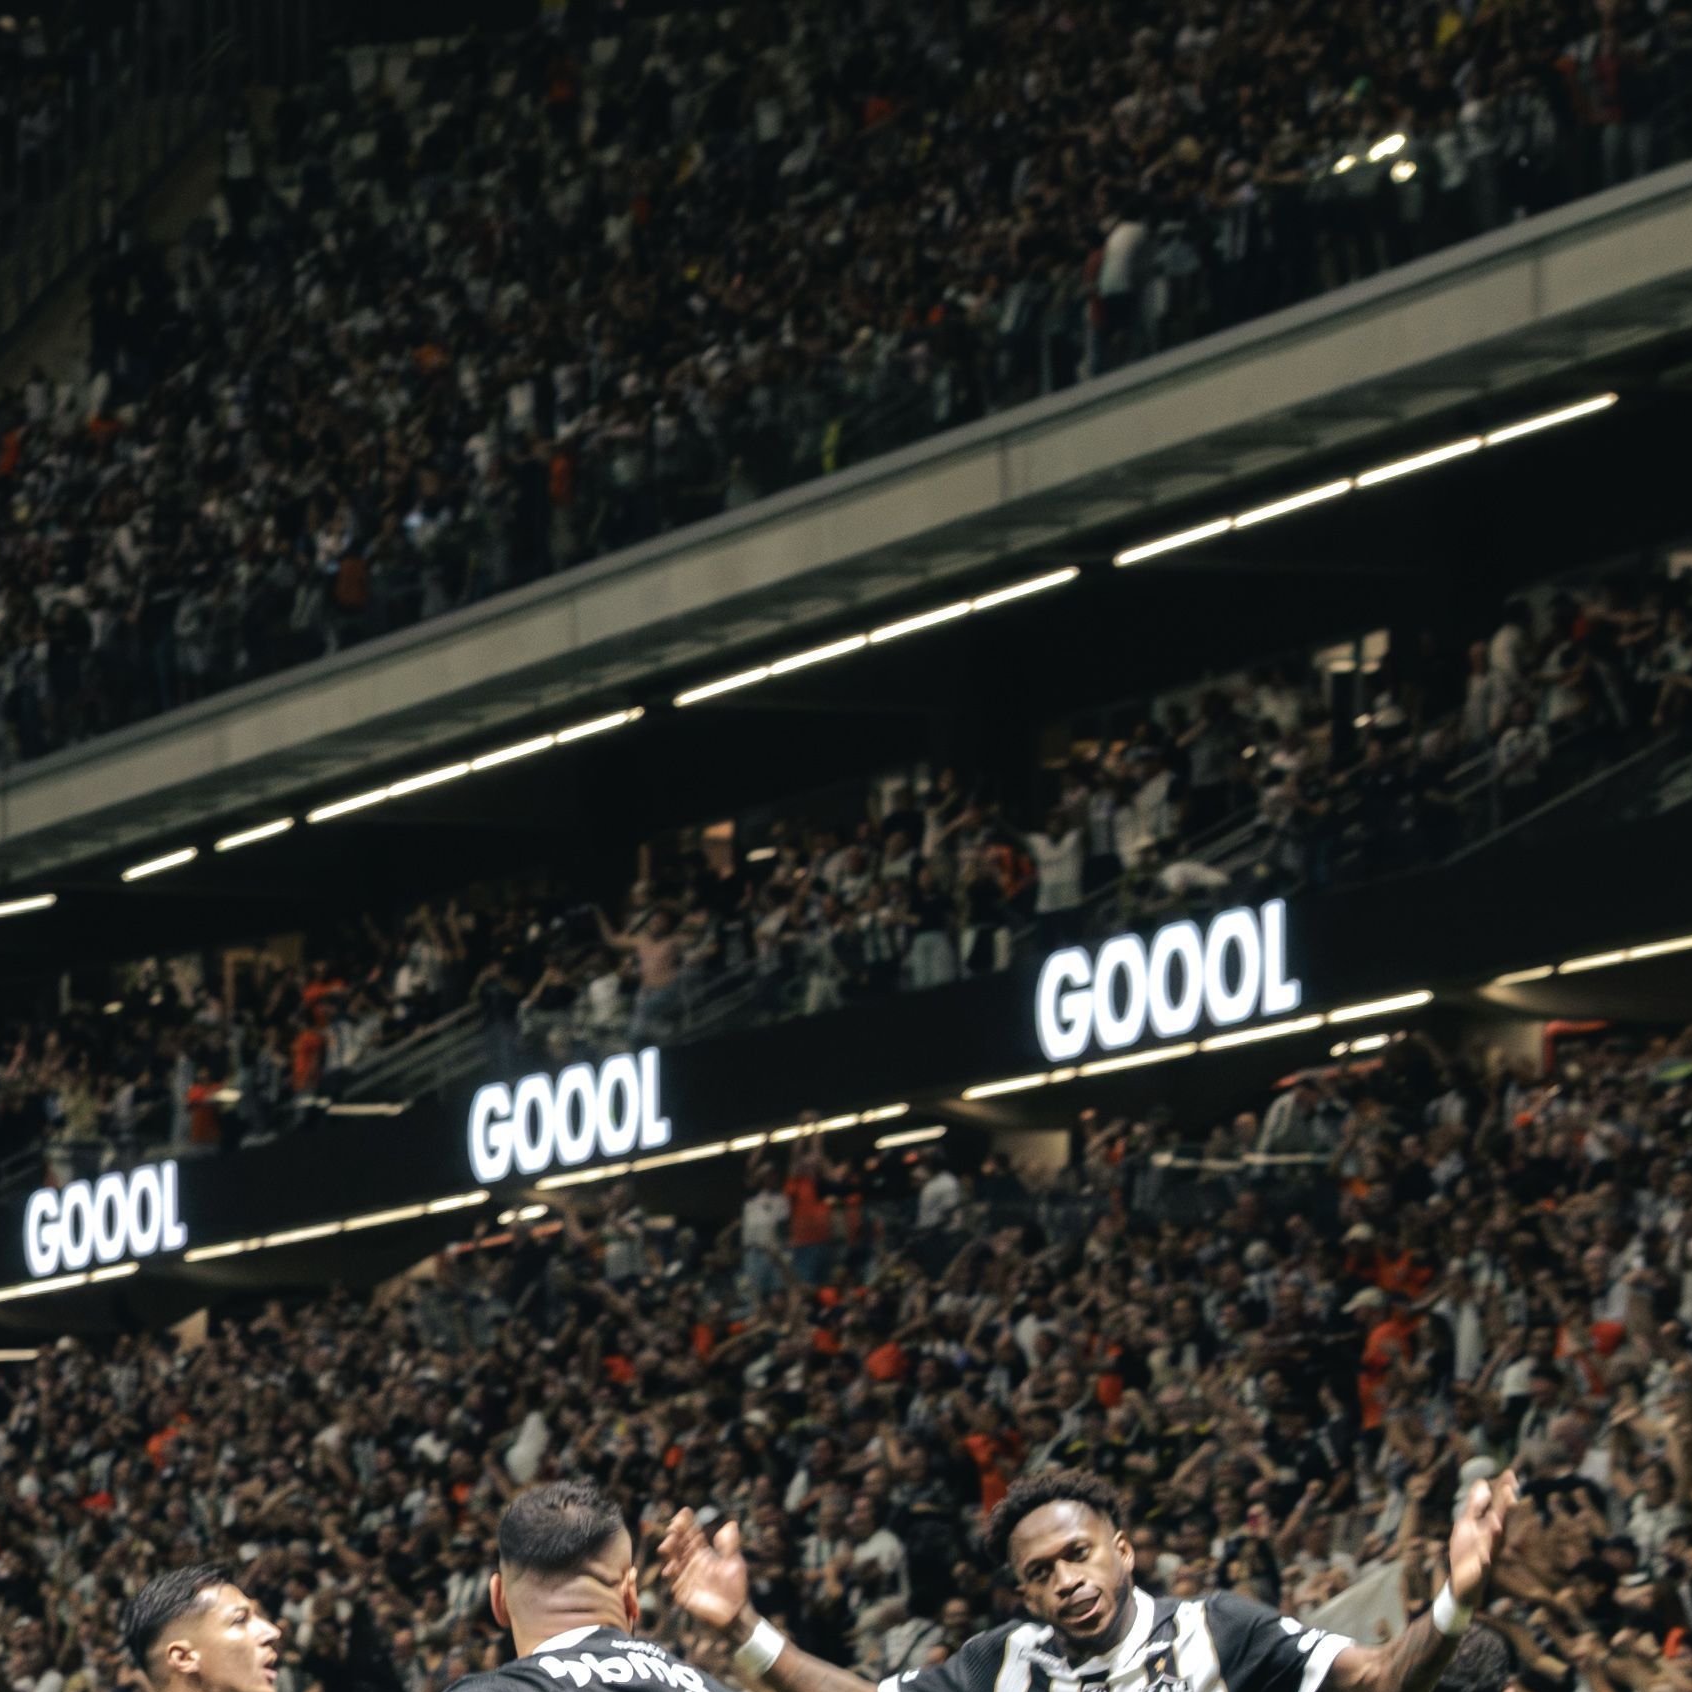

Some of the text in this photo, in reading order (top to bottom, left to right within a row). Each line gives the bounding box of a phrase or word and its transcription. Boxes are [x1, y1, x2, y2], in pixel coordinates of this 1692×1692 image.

[1035, 898, 1302, 1062] GOOOL
[467, 1046, 672, 1184] GOOOL
[23, 1159, 187, 1277] GOOOL
